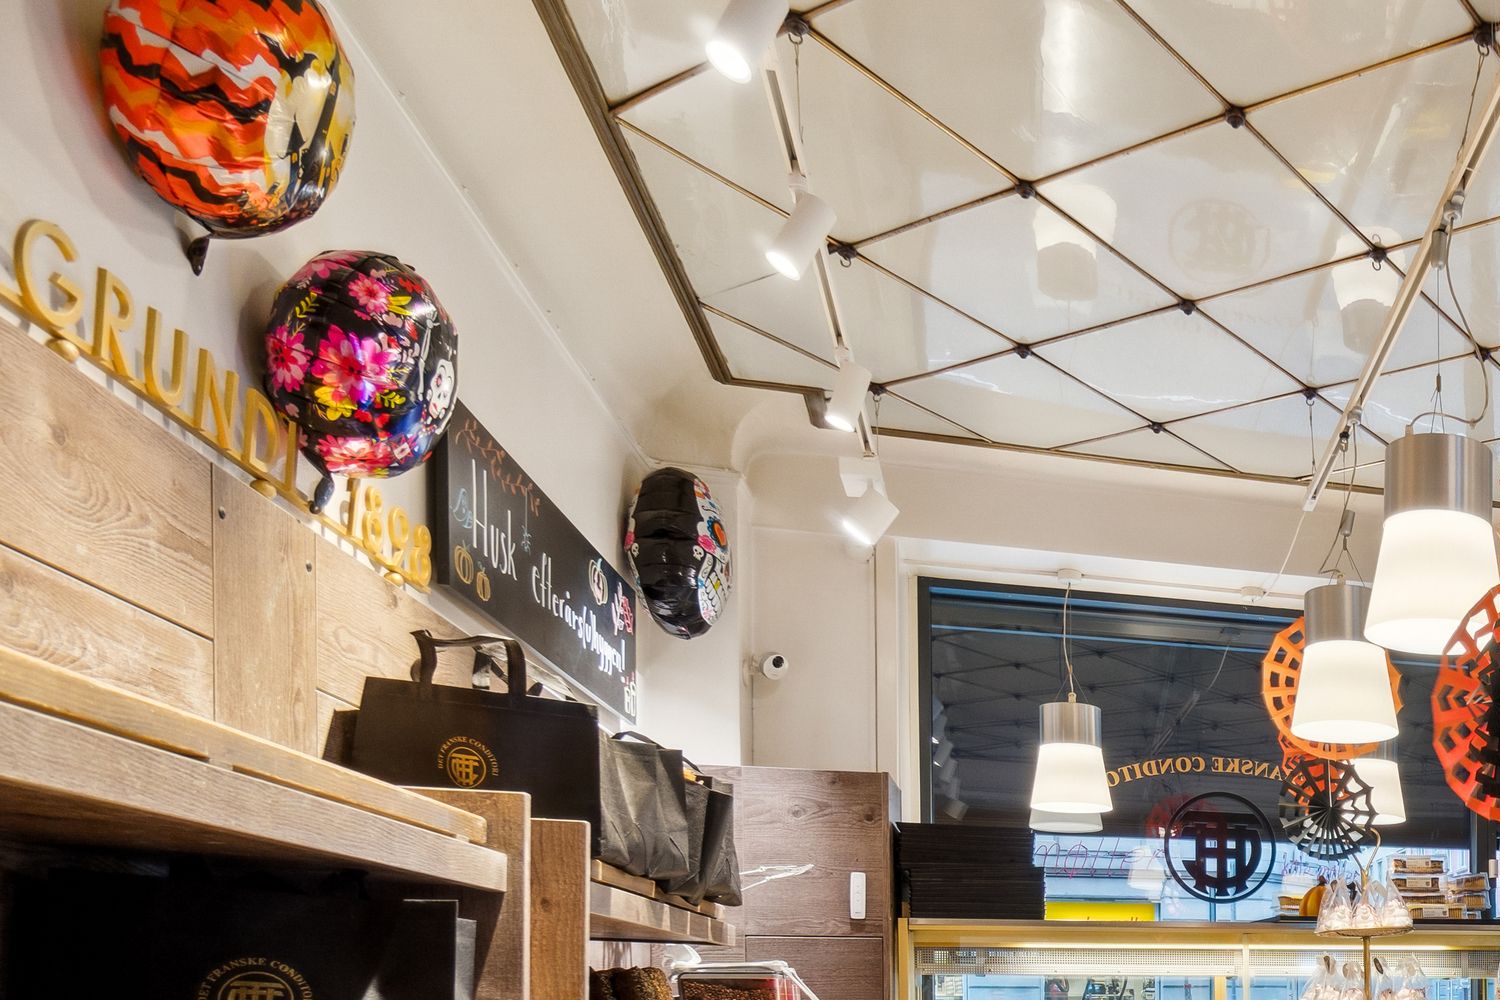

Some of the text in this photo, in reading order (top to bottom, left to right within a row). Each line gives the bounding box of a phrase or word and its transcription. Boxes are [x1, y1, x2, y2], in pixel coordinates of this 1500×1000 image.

[346, 477, 432, 588] 1898
[471, 458, 518, 581] Husk
[468, 738, 499, 777] CONDITORI
[206, 956, 266, 982] FRANSKE
